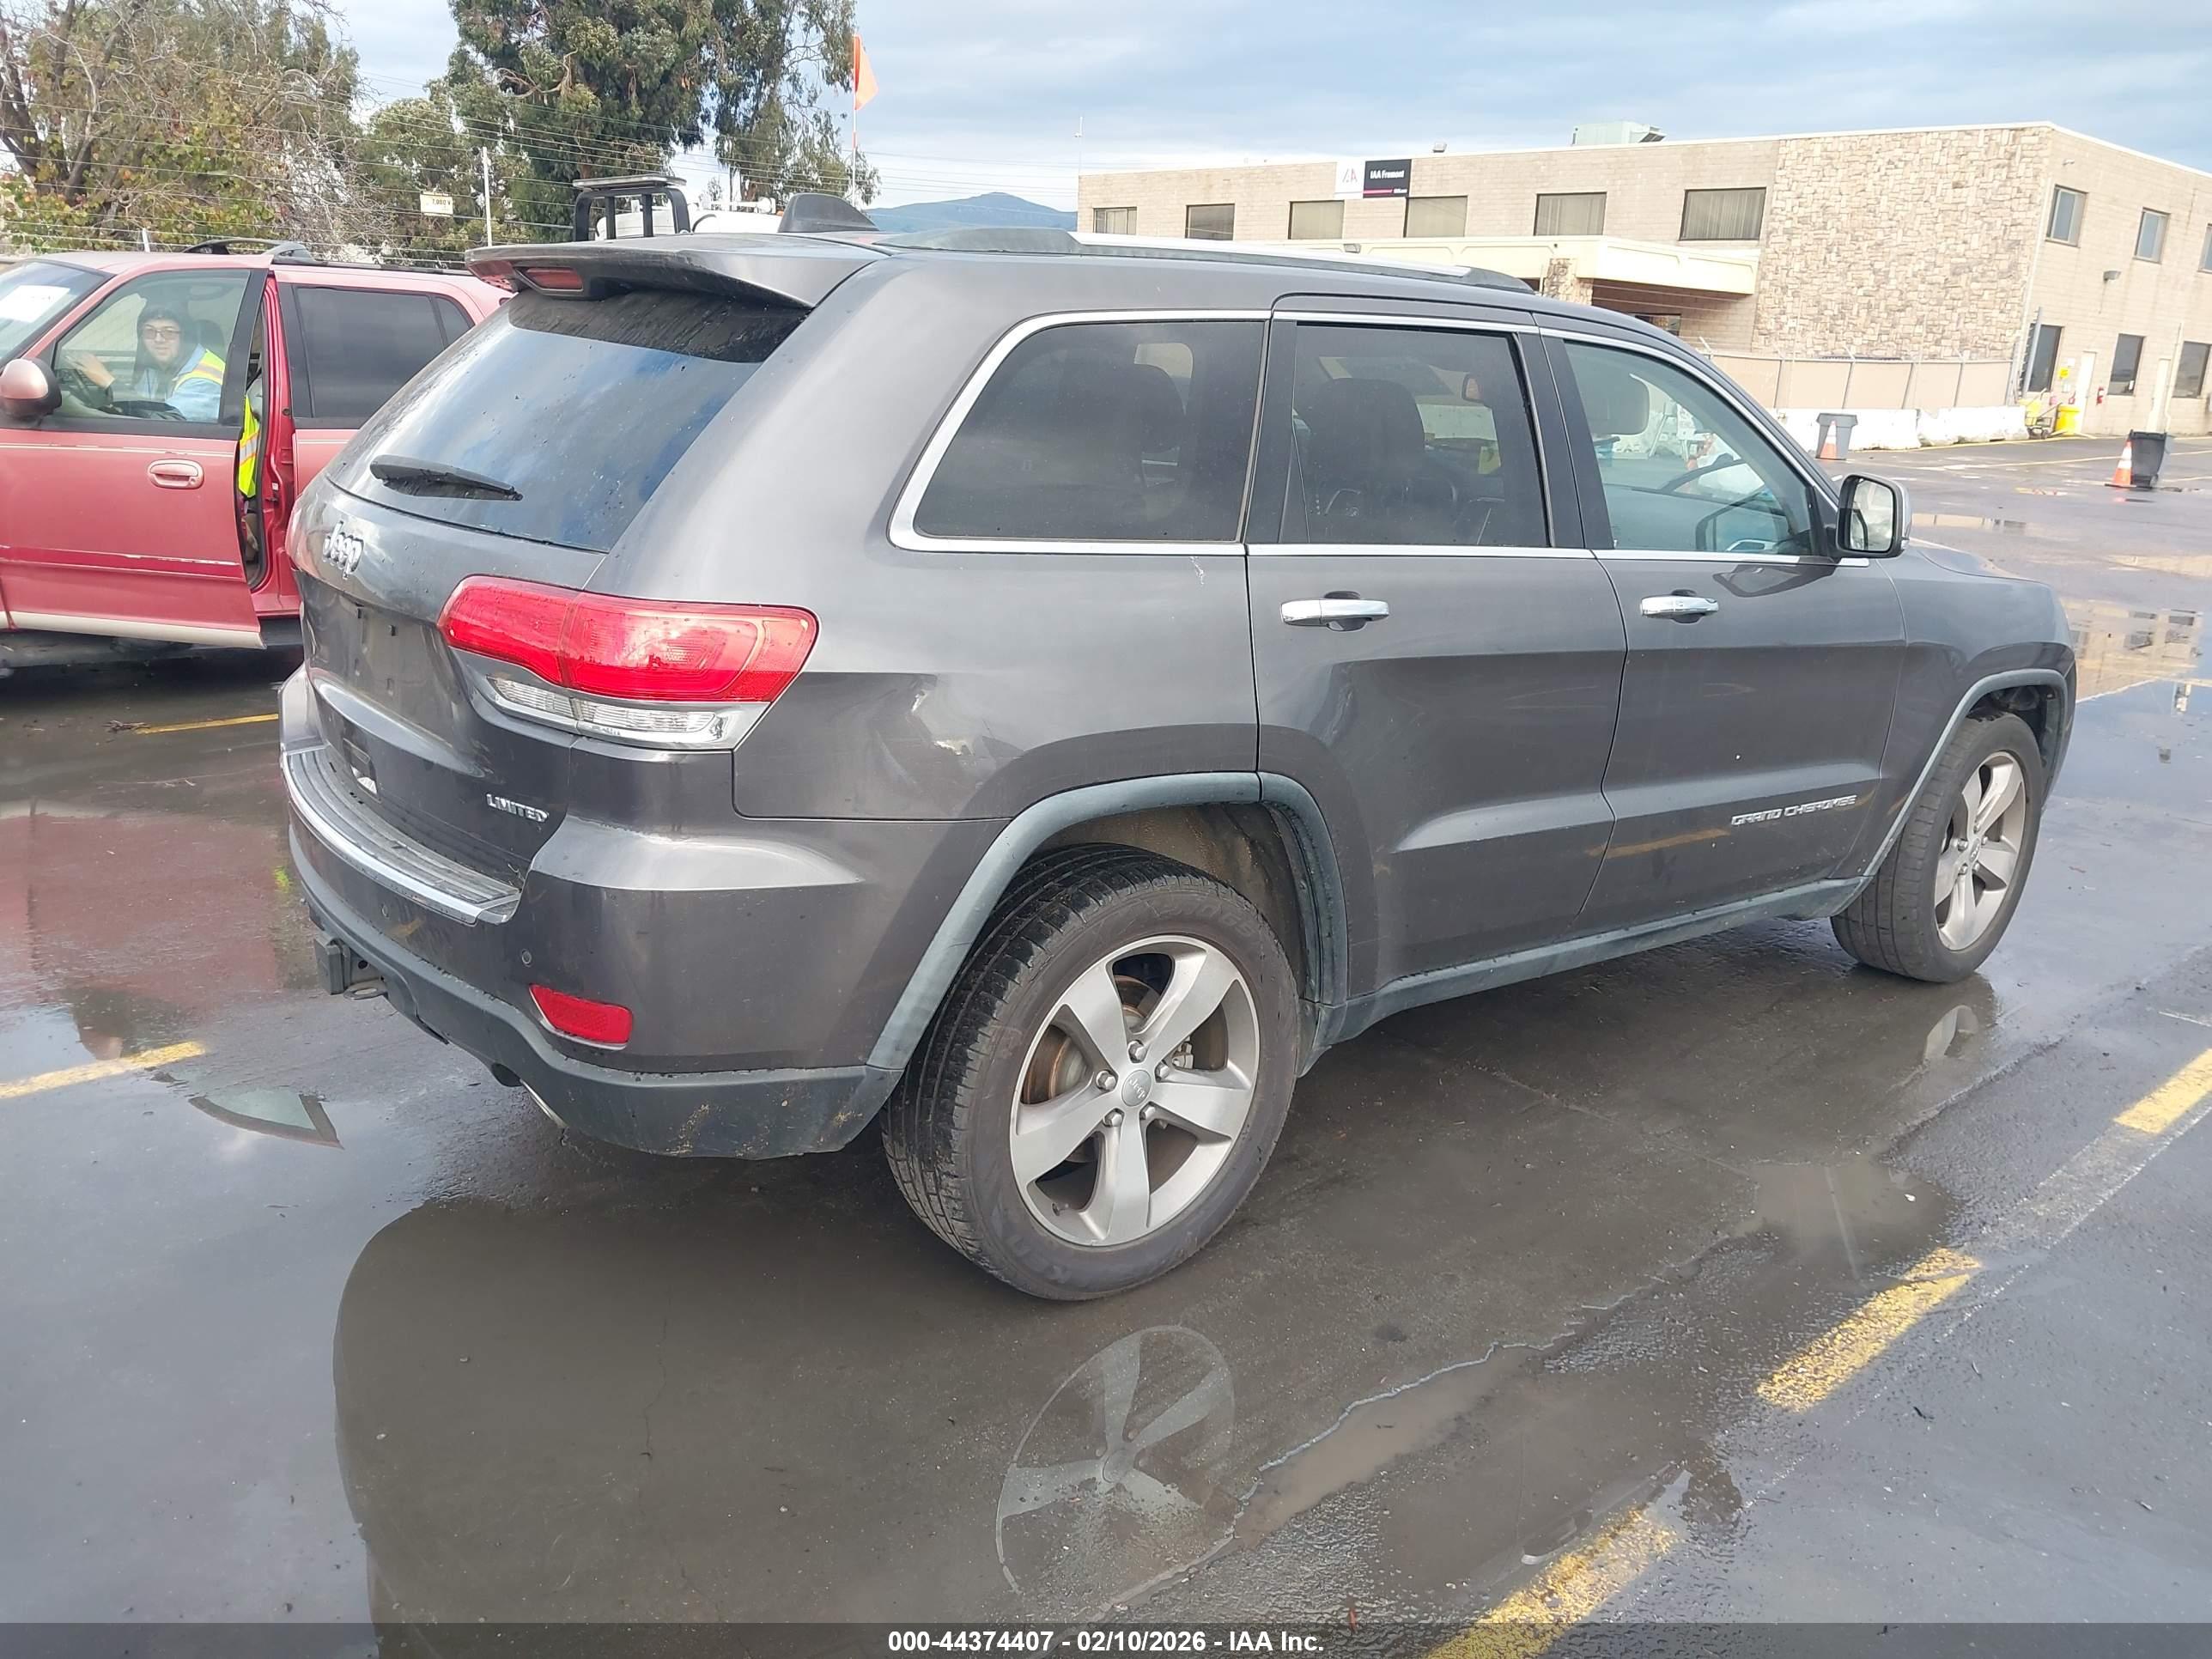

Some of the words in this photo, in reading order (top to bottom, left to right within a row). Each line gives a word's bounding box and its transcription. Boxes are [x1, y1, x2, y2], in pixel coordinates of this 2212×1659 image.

[323, 520, 362, 580] Jeep
[486, 793, 549, 822] LIMITED
[1731, 809, 1783, 825] GRAND
[1784, 795, 1857, 817] CHEROKEE
